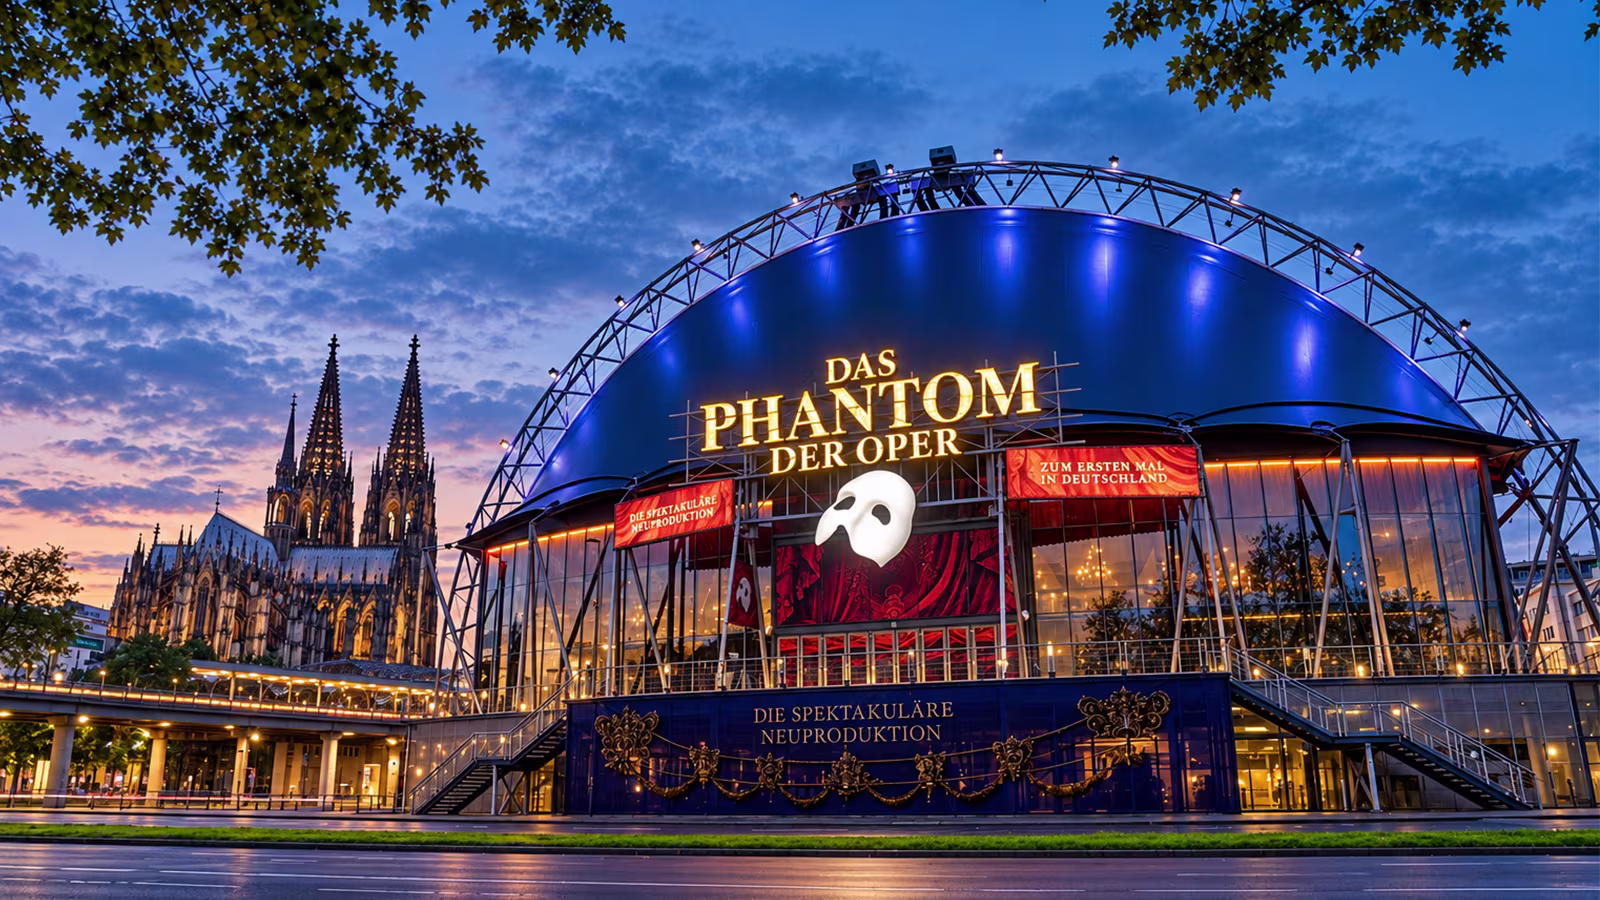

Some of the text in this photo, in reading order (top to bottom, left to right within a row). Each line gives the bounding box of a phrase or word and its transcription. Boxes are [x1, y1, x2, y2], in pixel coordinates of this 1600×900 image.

[825, 349, 897, 385] DAS
[700, 361, 1042, 452] PHANTOM
[769, 428, 963, 475] DER OPER
[1040, 461, 1165, 472] ZUM ERSTEN MAL
[1041, 473, 1168, 484] IN DEUTSCHLAND
[630, 495, 717, 523] DIE SPEKTAKULÄRE
[631, 507, 714, 533] NEUPRODUKTION
[753, 700, 954, 724] DIE SPEKTAKULÄRE
[761, 724, 941, 745] NEUPRODUKTION
